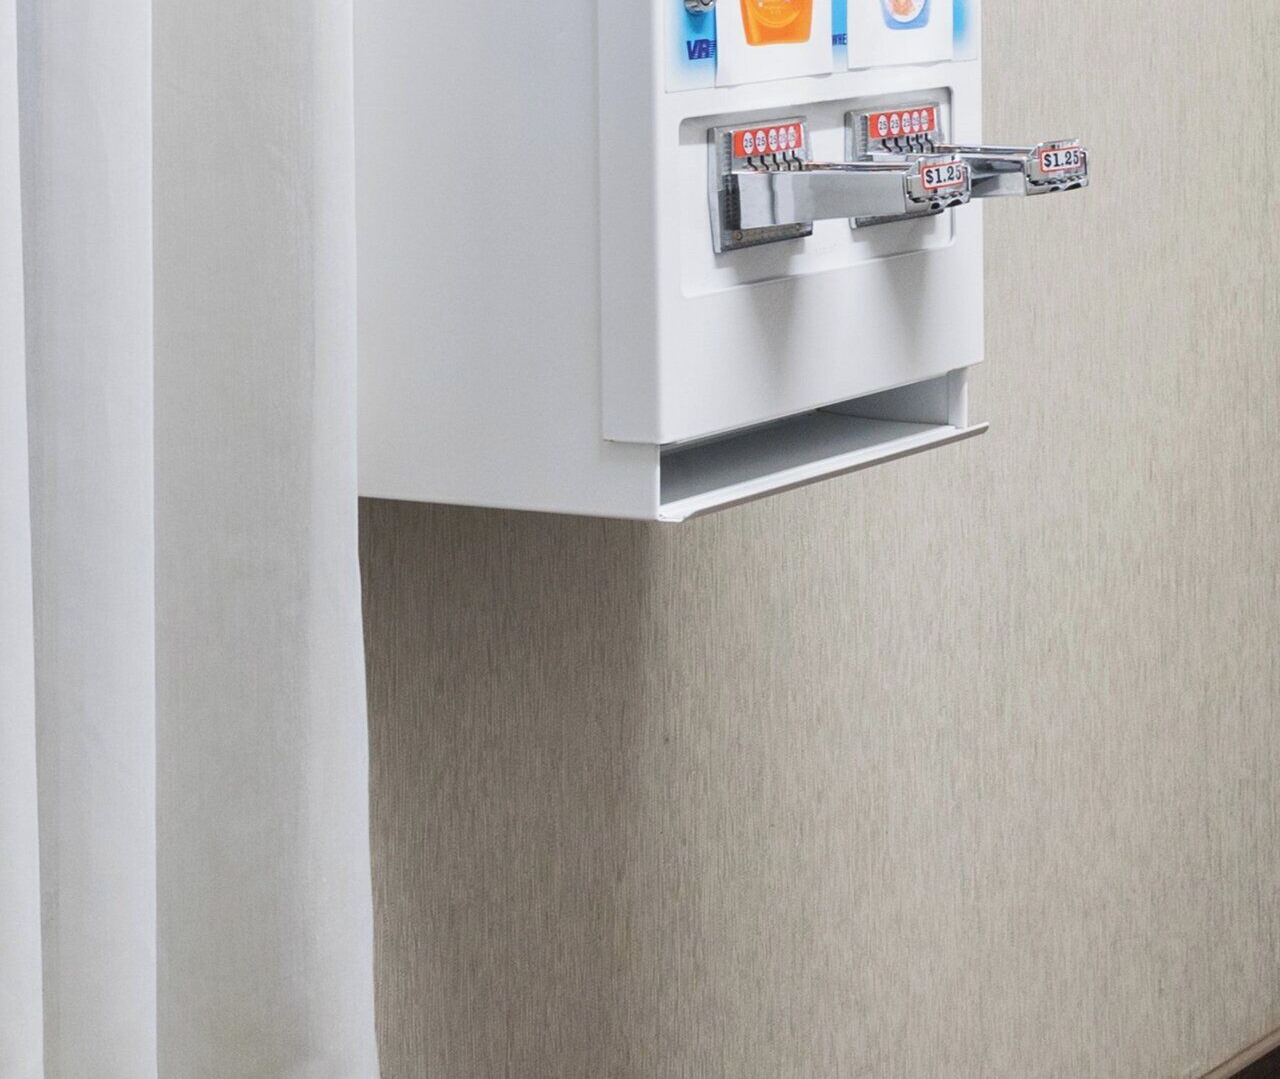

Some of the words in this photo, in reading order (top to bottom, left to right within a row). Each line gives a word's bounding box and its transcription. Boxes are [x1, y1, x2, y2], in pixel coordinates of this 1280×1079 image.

[879, 121, 887, 131] 25
[891, 119, 899, 129] 25
[744, 137, 752, 148] 25
[757, 136, 765, 146] 25
[1043, 149, 1080, 168] $1.25
[925, 164, 962, 185] $1.25
